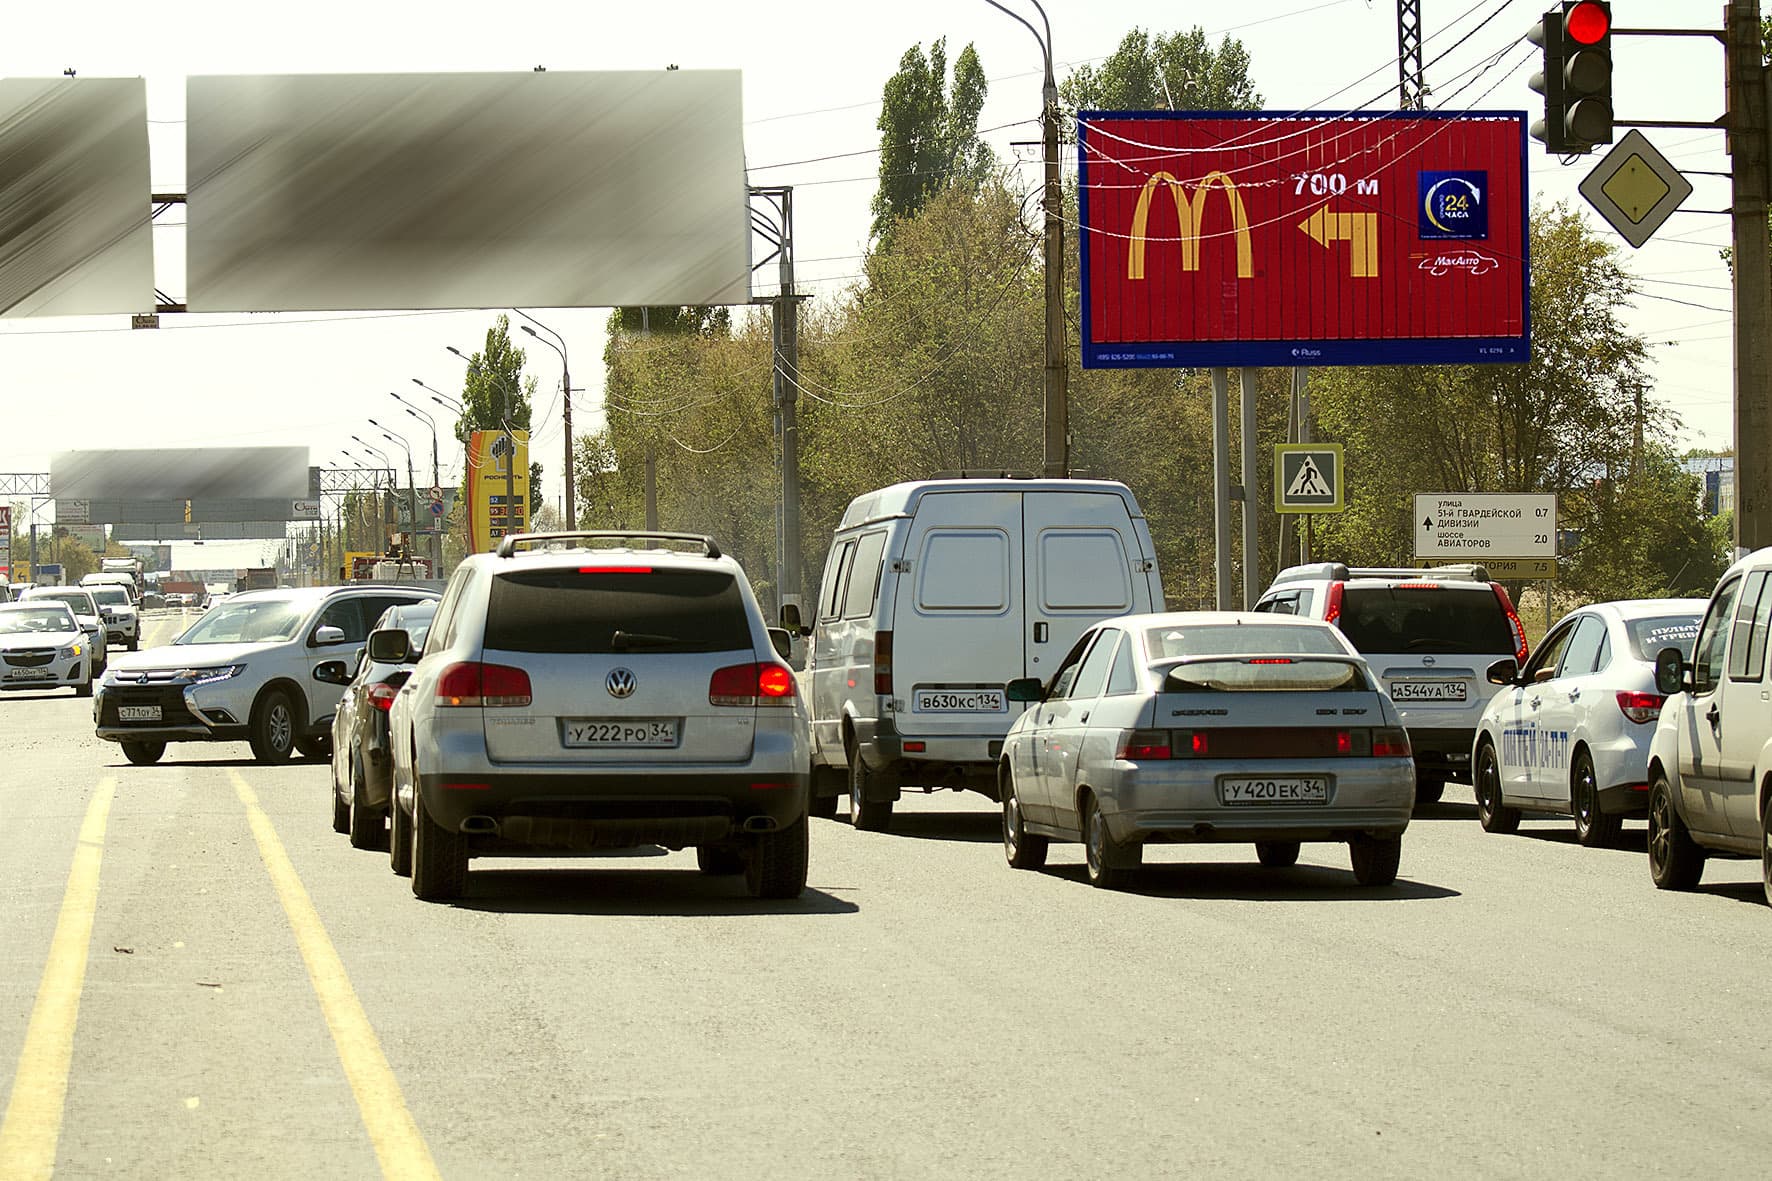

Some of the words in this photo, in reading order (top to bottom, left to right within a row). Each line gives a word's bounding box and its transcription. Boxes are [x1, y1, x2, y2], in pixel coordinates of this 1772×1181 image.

[1292, 173, 1346, 195] 700
[1445, 194, 1469, 211] 24
[1438, 500, 1462, 508] улица
[1438, 510, 1454, 518] 51-й
[1458, 508, 1522, 518] ГВАРДЕЙСКОЙ
[1535, 508, 1548, 518] 0.7
[1438, 520, 1480, 528] ДИВИЗИИ
[1438, 540, 1490, 548] АВИАТОРОВ
[1534, 535, 1548, 544] 2.0
[1646, 636, 1656, 644] И
[1658, 632, 1699, 640] ТРЕВ
[1396, 684, 1442, 696] А544УА
[1444, 684, 1462, 694] 134
[924, 695, 975, 708] В630КС
[978, 694, 998, 704] 134
[572, 724, 646, 742] У222РО
[652, 724, 668, 736] 34
[1232, 782, 1299, 798] У420ЕК
[1304, 780, 1320, 792] 34
